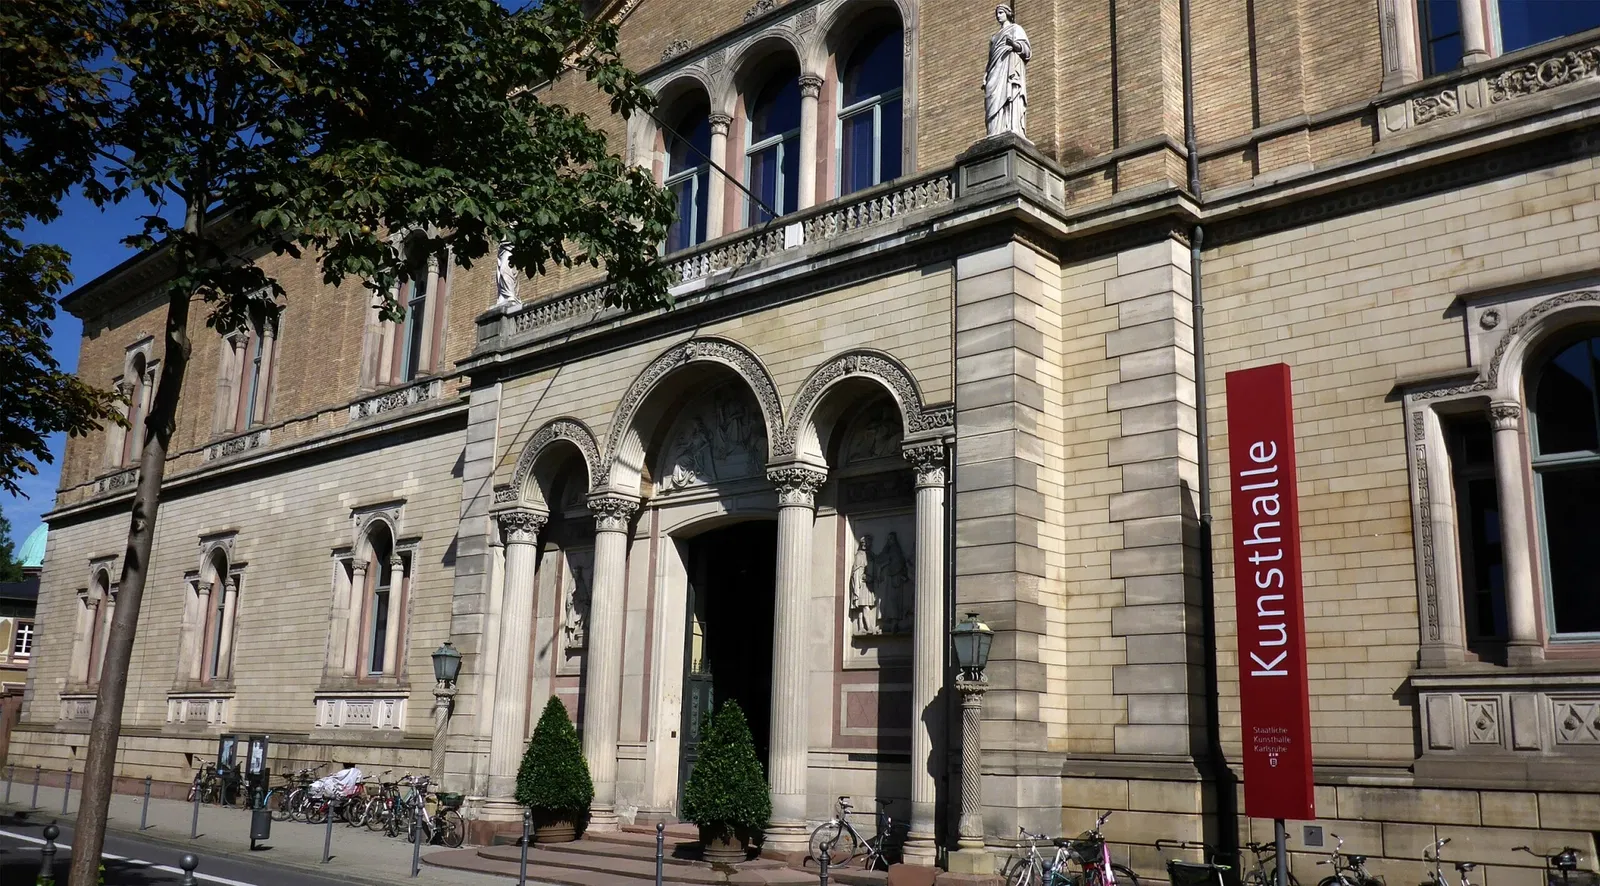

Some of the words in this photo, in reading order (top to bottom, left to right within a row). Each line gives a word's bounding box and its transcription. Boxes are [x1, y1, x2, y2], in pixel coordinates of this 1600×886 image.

[1240, 440, 1288, 677] Kunsthalle
[1253, 735, 1291, 743] Kunsthalle
[1253, 744, 1288, 752] Karlsruhe
